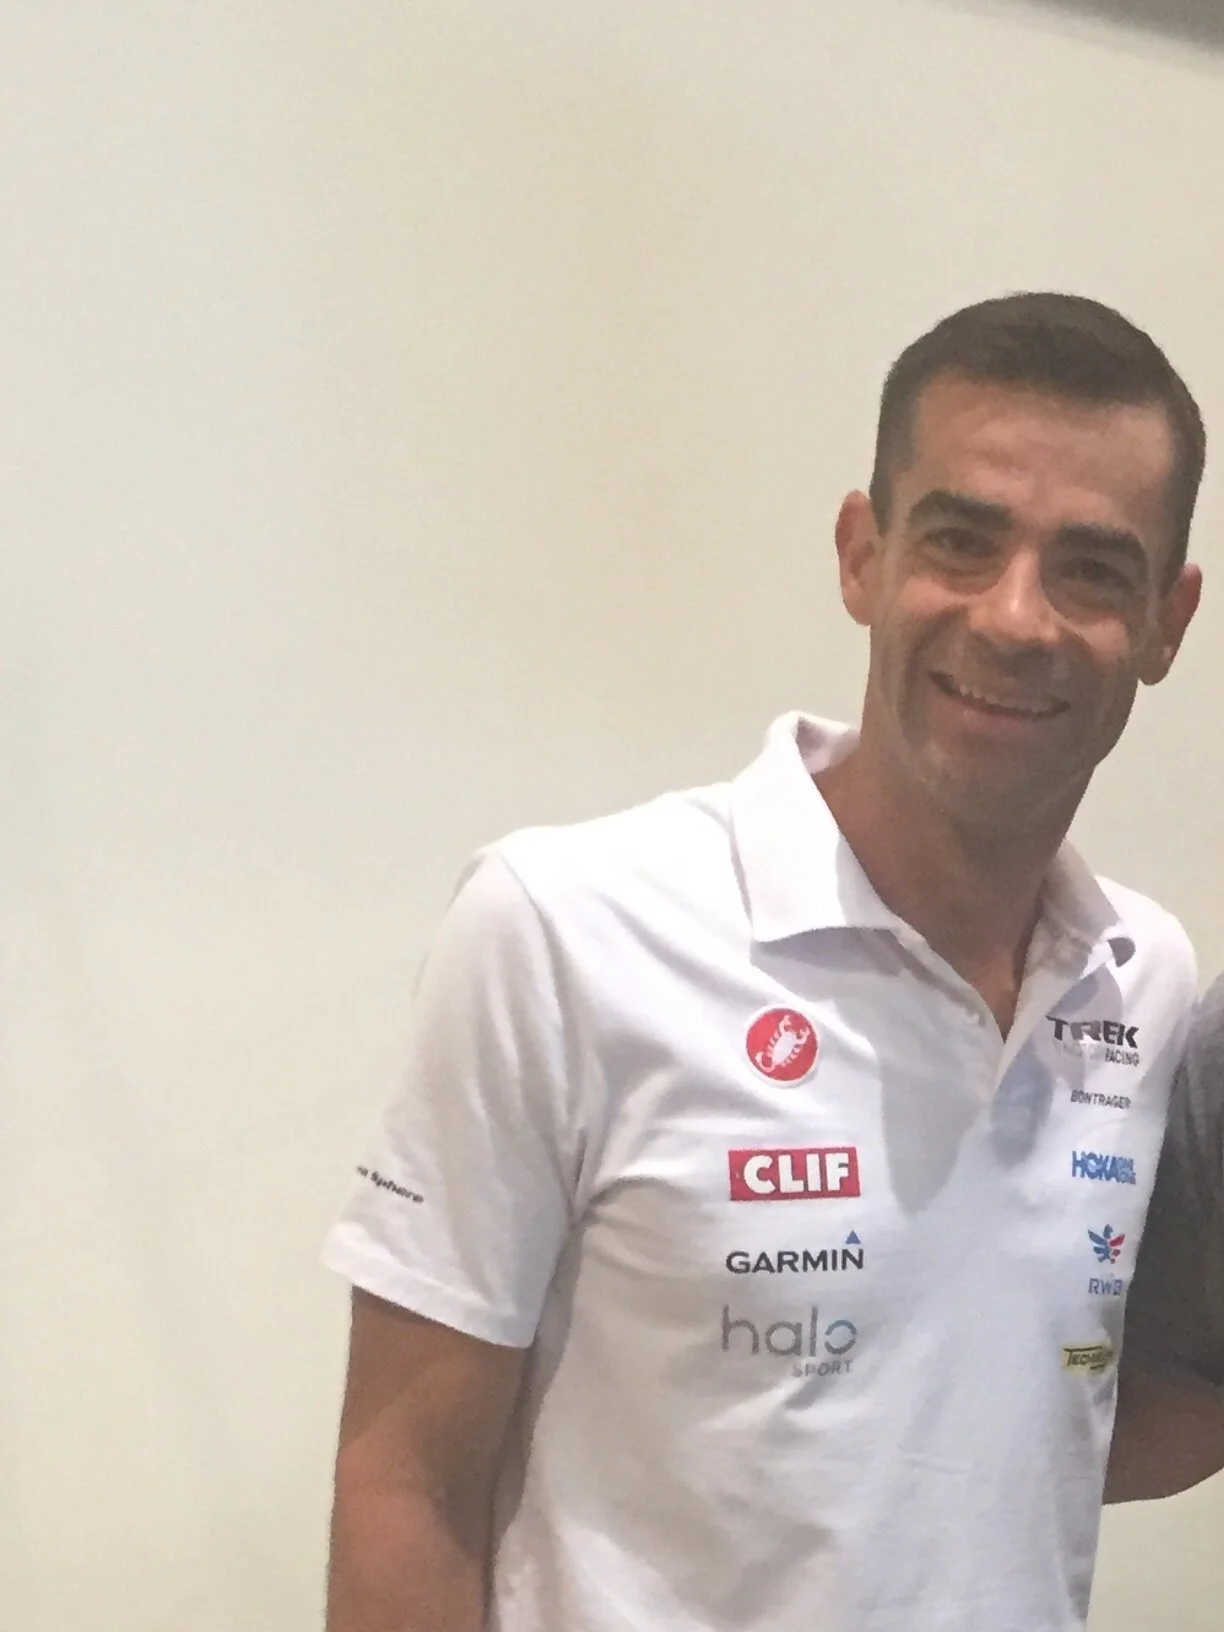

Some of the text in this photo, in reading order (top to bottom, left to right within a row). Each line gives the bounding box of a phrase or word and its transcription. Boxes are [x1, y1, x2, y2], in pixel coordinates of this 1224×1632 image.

[1045, 1015, 1139, 1049] TREK
[1070, 1088, 1131, 1109] BONTRAGER
[743, 1153, 850, 1194] CLIF
[726, 1248, 864, 1275] GARMIN
[722, 1303, 858, 1357] halo
